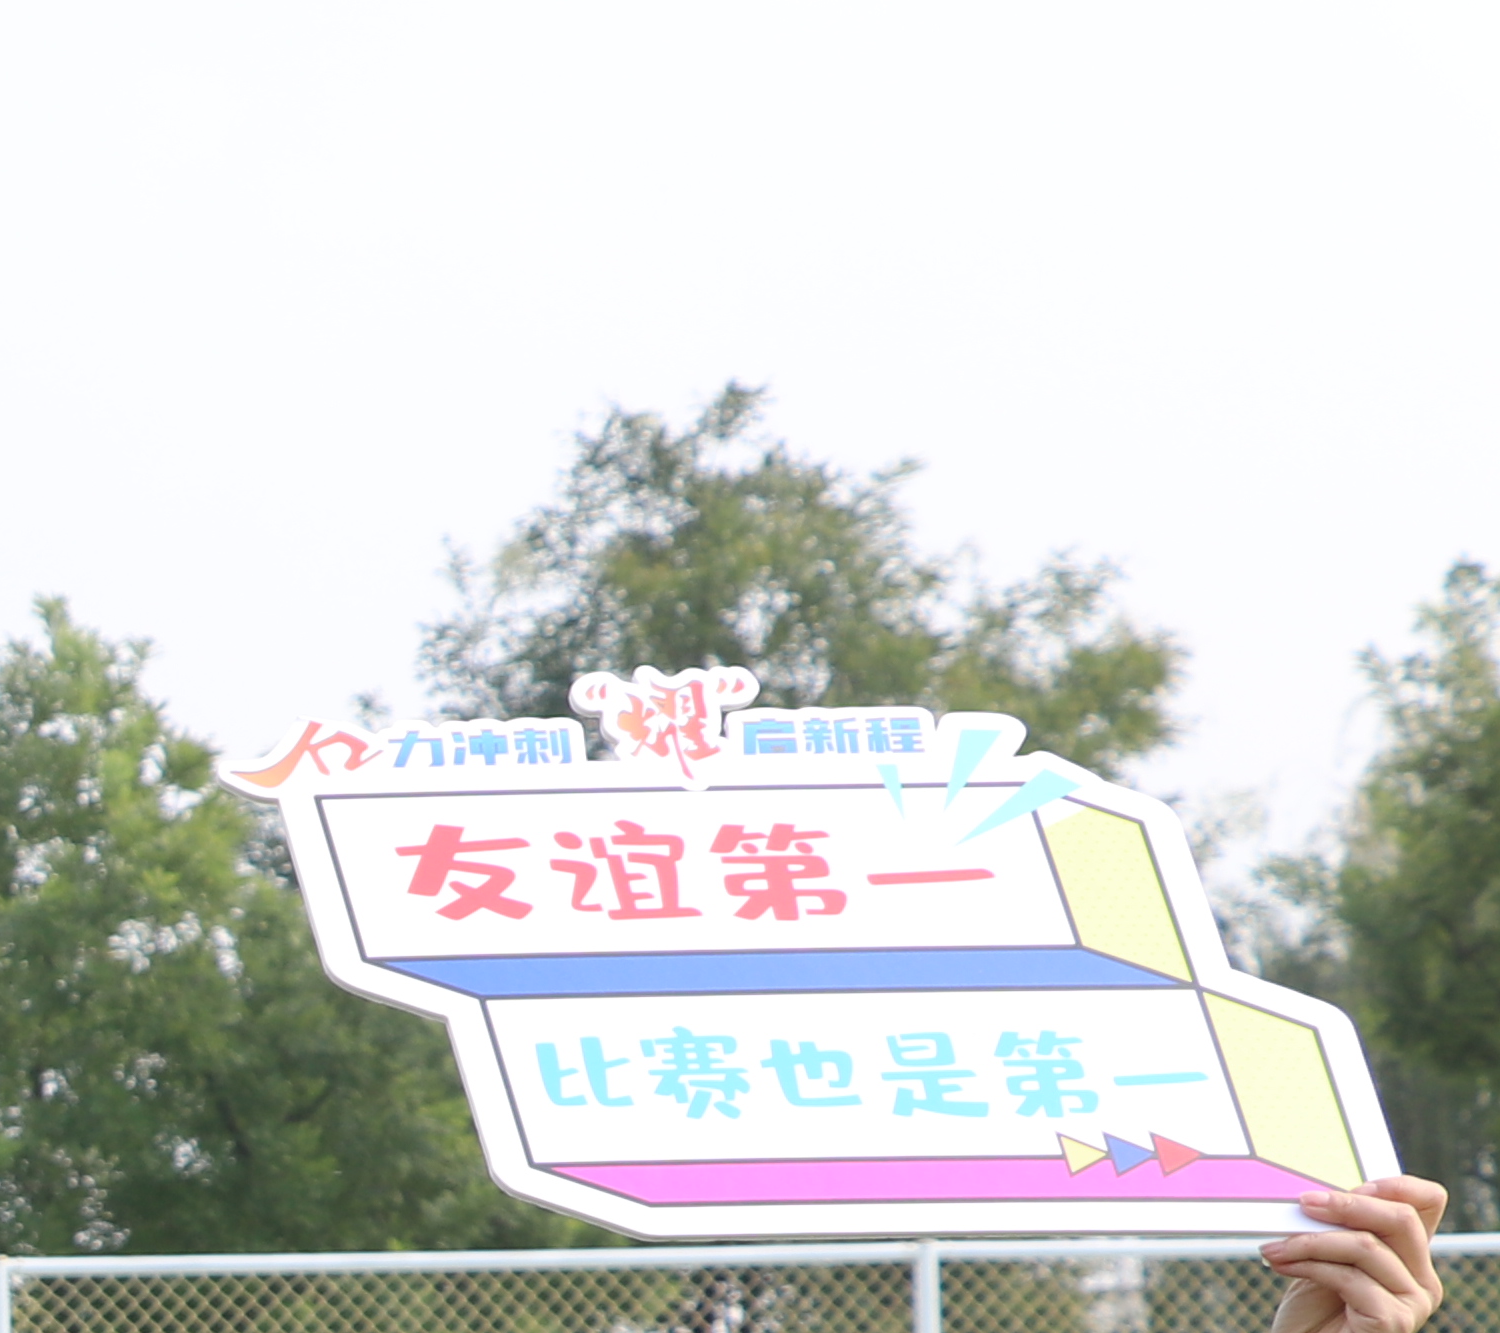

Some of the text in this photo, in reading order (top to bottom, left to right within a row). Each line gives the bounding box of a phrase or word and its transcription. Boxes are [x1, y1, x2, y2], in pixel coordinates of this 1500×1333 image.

[396, 818, 995, 922] 友谊第一
[535, 1026, 1209, 1119] 比赛也是第一
